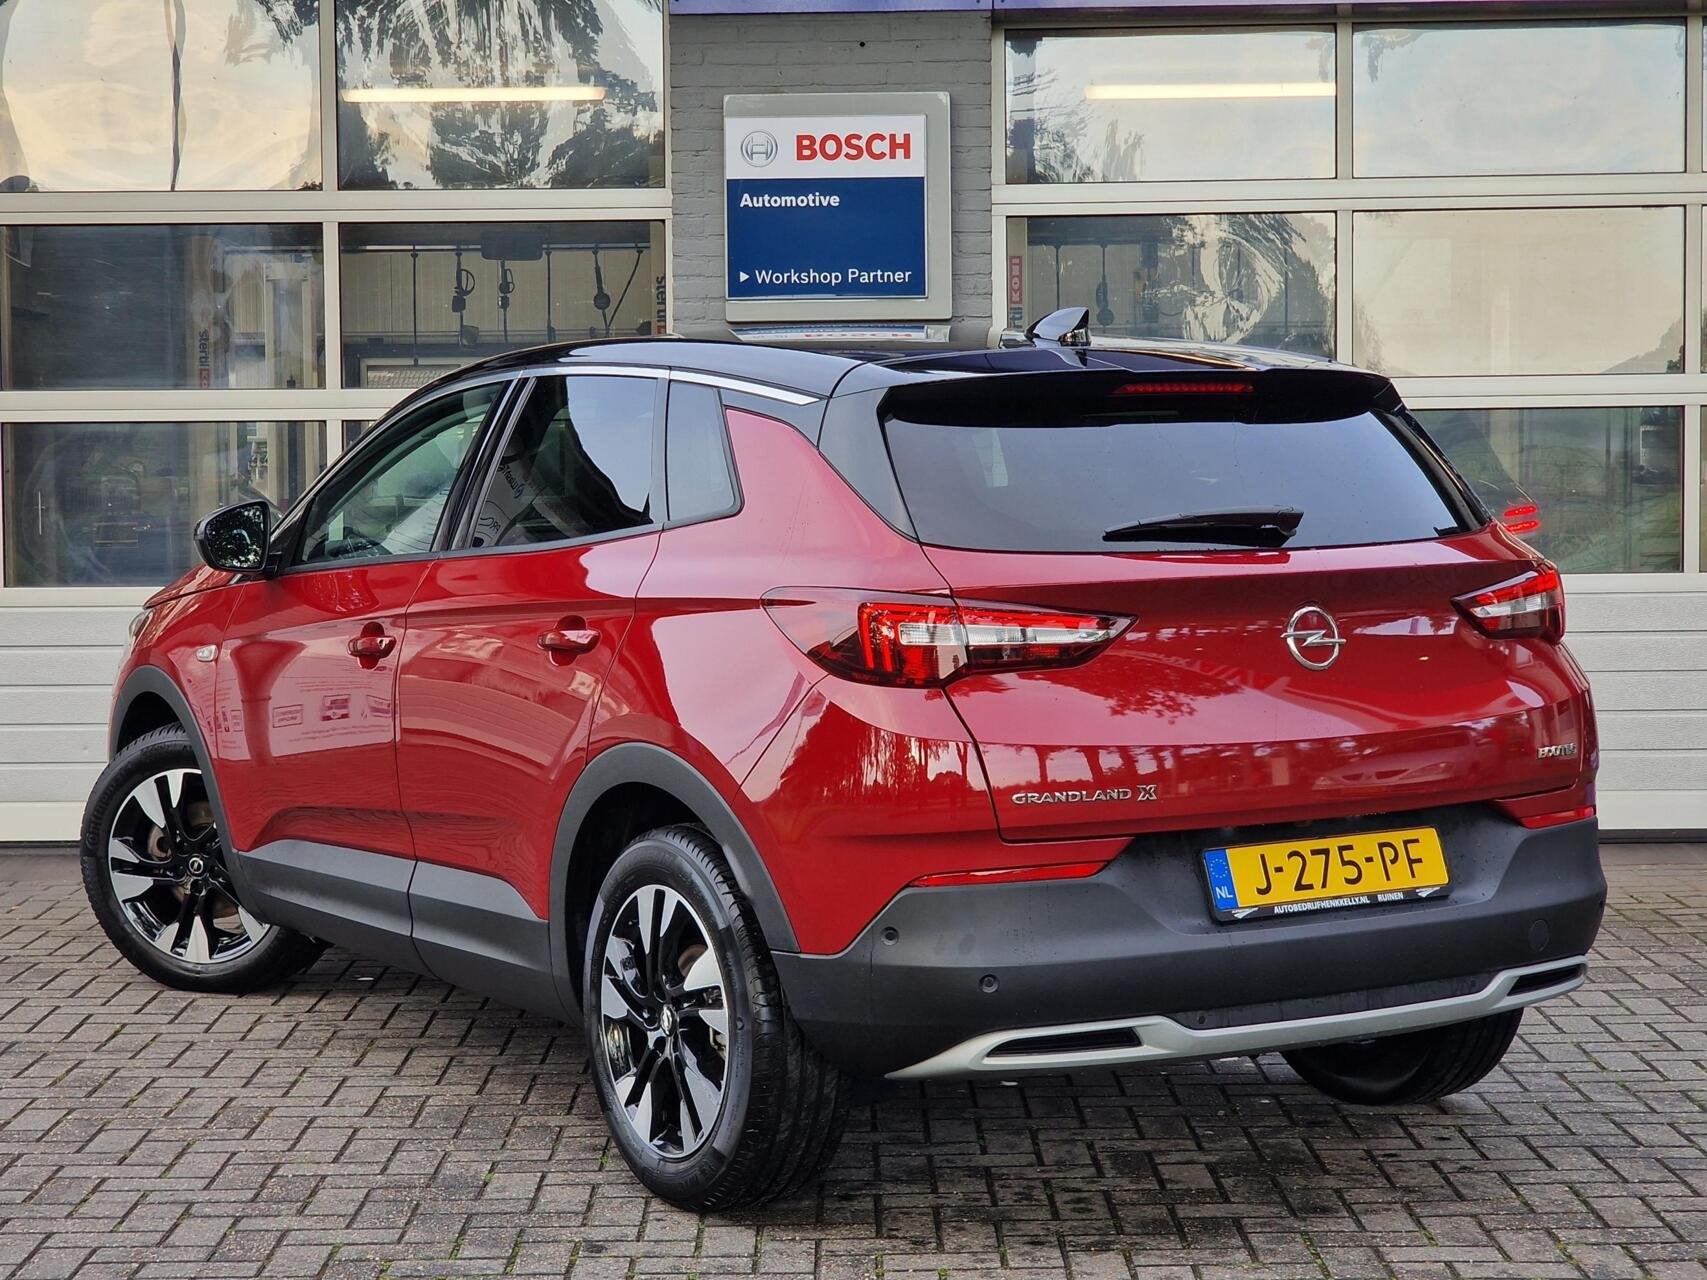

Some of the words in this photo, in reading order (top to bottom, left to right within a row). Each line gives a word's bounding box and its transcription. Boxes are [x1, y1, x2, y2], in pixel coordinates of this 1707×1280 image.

[796, 133, 911, 161] BOSCH
[740, 192, 840, 208] Automotive
[755, 269, 842, 286] Workshop
[848, 268, 912, 283] Partner
[1011, 788, 1132, 804] GRANDLAND
[1137, 784, 1157, 800] X
[1256, 838, 1423, 896] J-275-PF
[1216, 886, 1233, 899] NL
[1274, 896, 1370, 914] AUTOBEDRIJFHENKKELLY.NL
[1377, 891, 1404, 902] RUINEN
